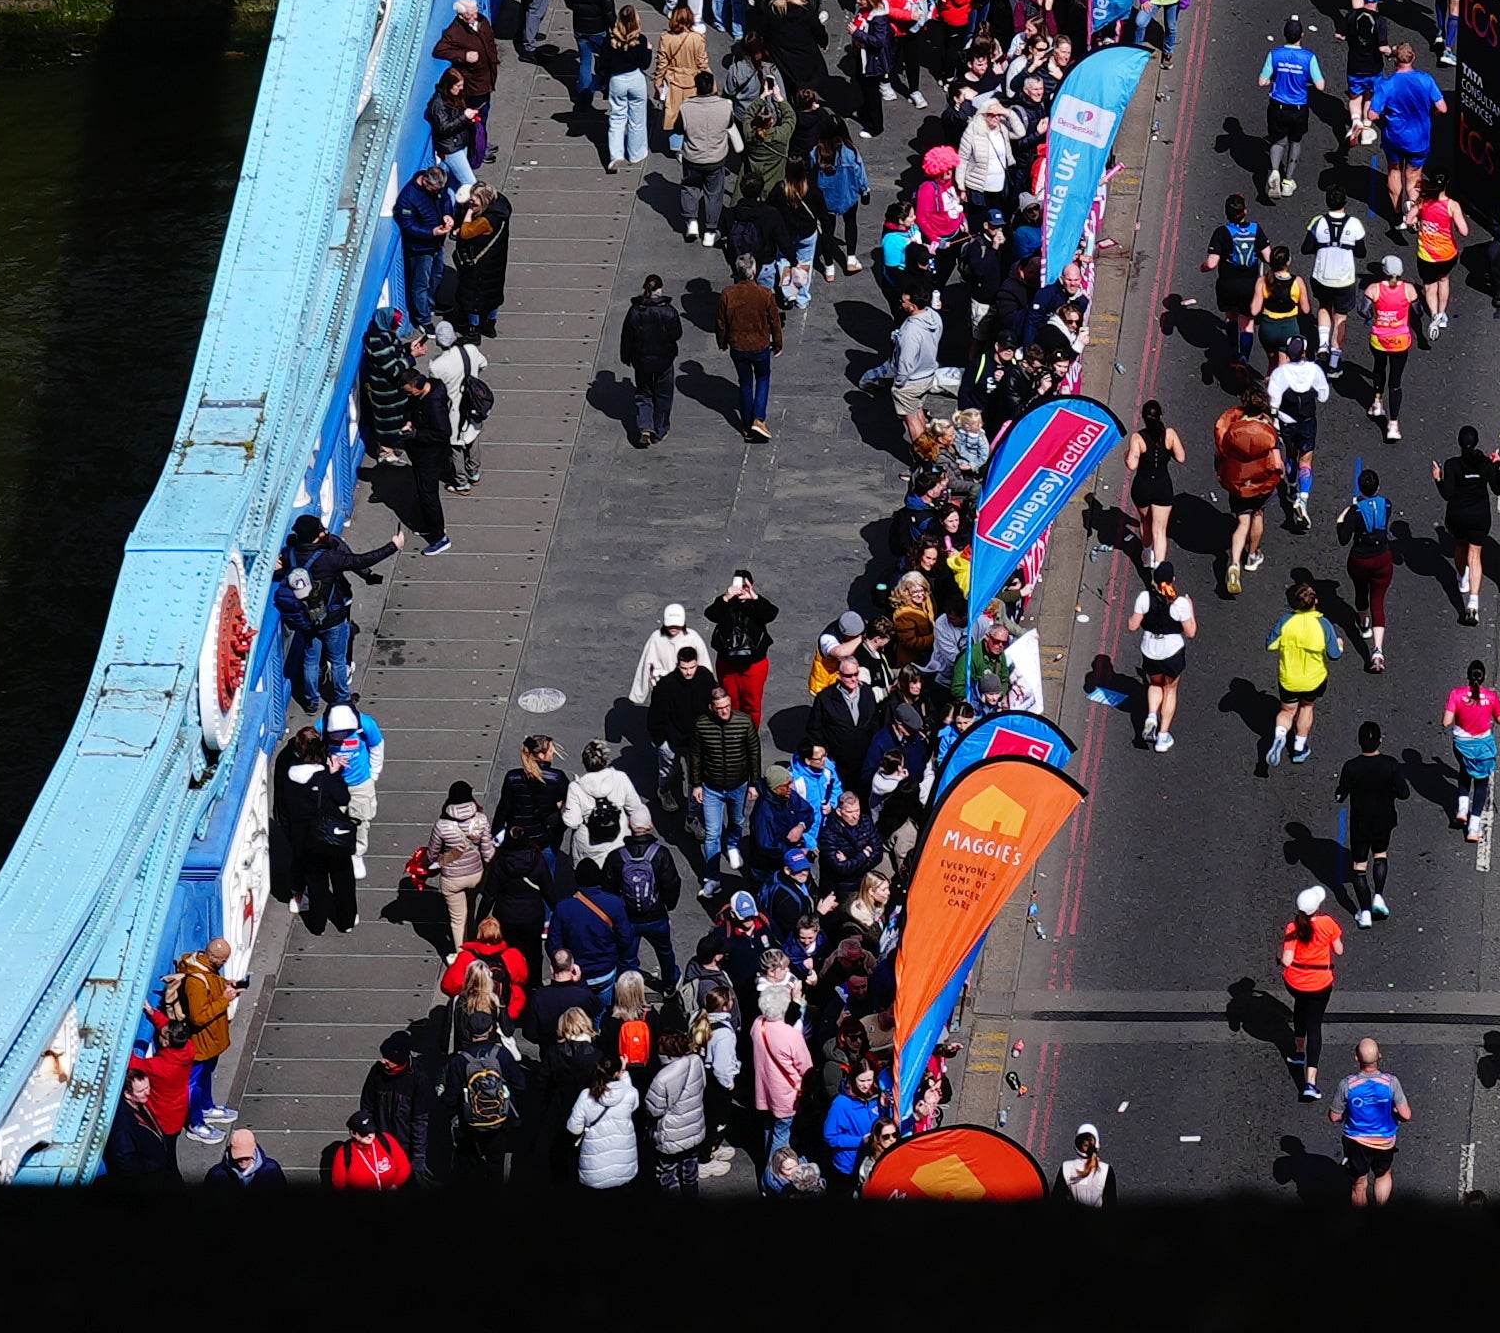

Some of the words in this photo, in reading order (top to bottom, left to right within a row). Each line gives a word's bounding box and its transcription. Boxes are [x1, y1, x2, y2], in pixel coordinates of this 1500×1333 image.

[1461, 62, 1484, 89] TATA
[1460, 92, 1493, 127] SERVICES
[1459, 112, 1494, 175] tcs
[1055, 148, 1081, 181] UK
[1001, 472, 1064, 542] epilepsy
[1056, 423, 1100, 474] action
[943, 872, 971, 886] HOME
[975, 880, 988, 891] OF
[943, 885, 981, 902] CANCER
[947, 899, 971, 912] CARE
